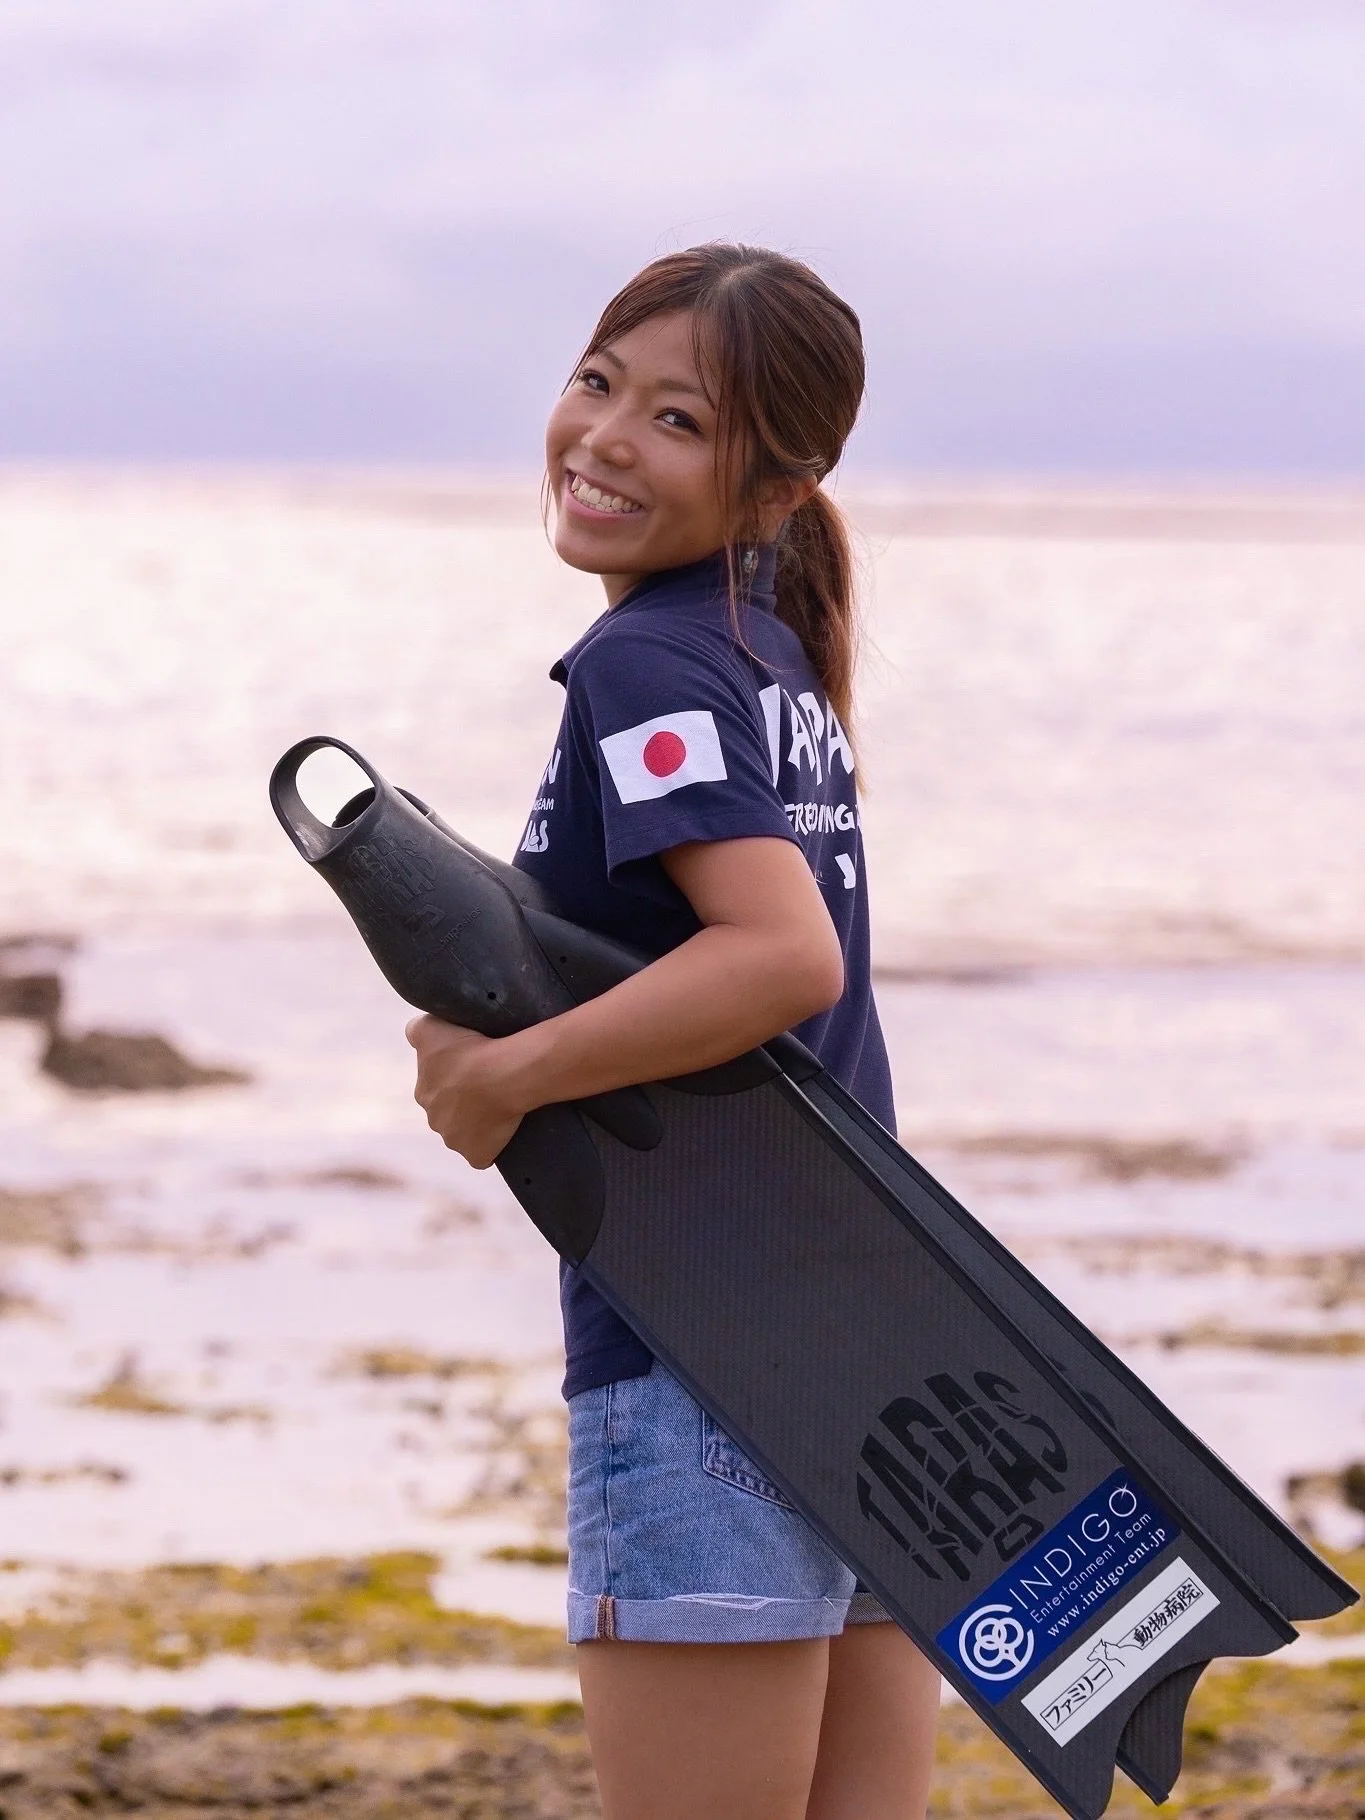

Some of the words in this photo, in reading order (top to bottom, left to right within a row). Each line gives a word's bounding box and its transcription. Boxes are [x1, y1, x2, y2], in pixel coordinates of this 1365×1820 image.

[1009, 1485, 1137, 1610] INDIGO
[1030, 1545, 1116, 1624] Entertainment
[1115, 1513, 1152, 1544] Team
[1047, 1528, 1167, 1637] www.indigo-ent.jp
[1046, 1667, 1108, 1725] ファミリー
[1133, 1585, 1200, 1646] 動物病院
